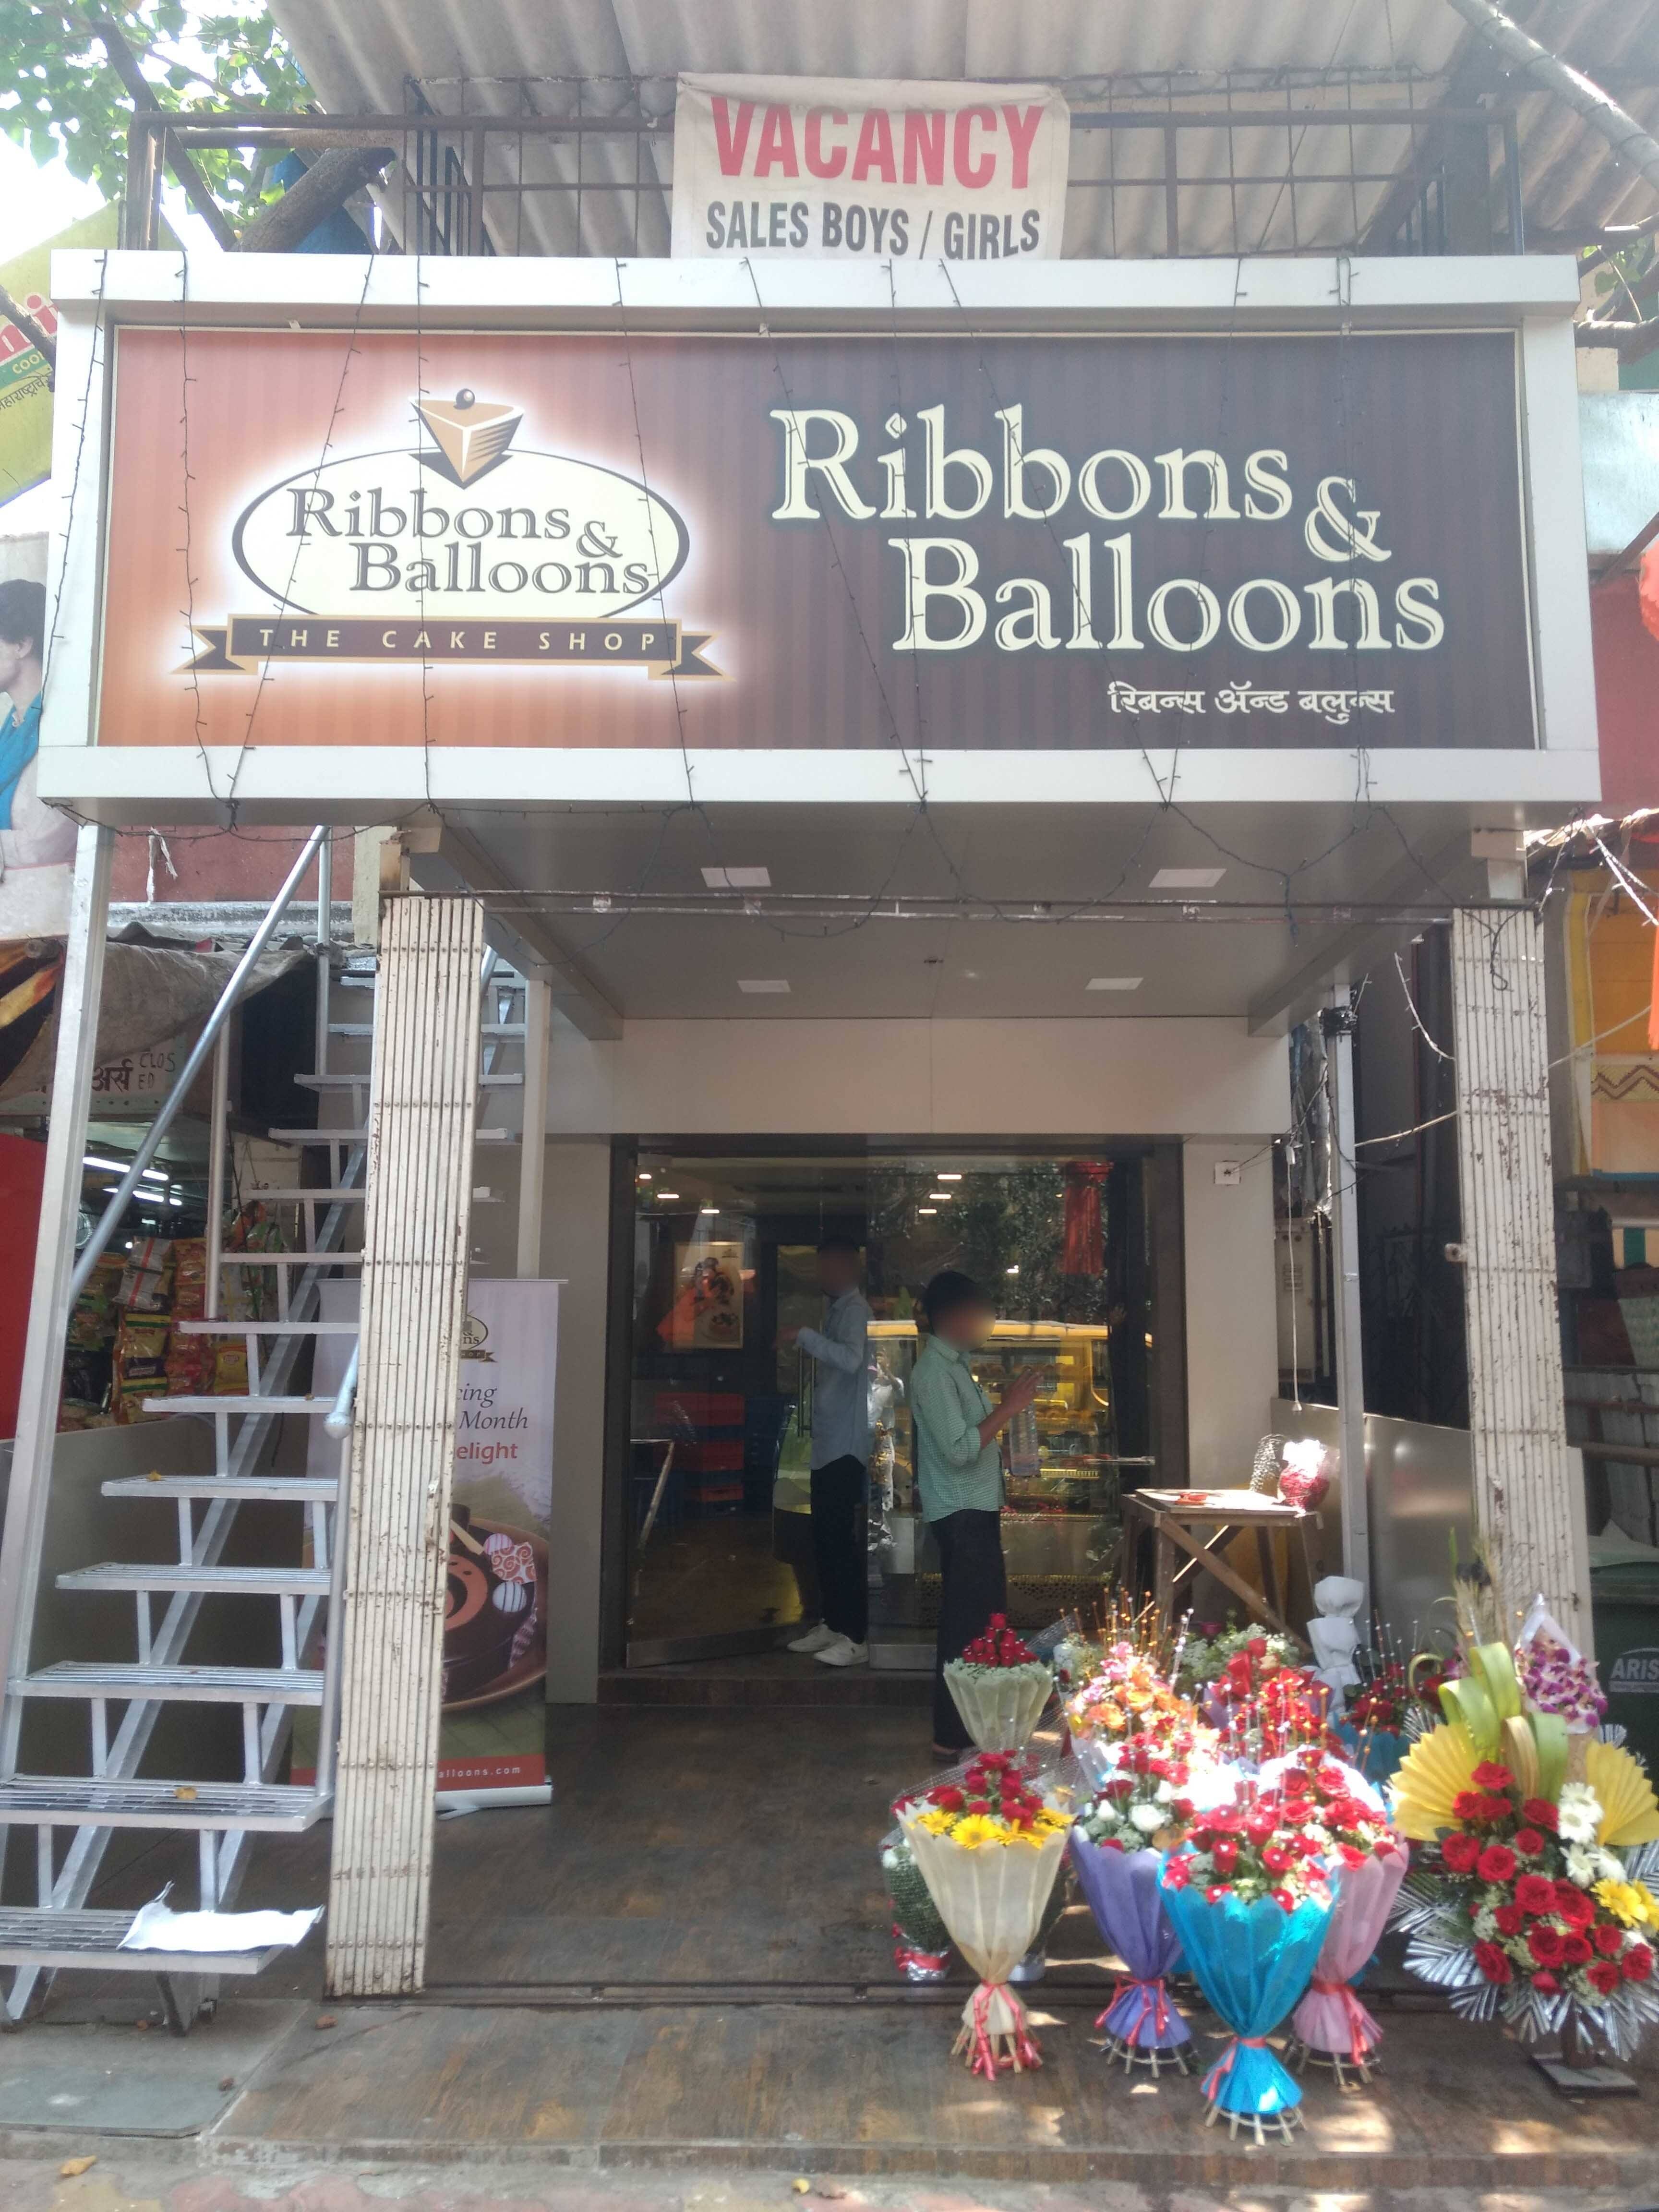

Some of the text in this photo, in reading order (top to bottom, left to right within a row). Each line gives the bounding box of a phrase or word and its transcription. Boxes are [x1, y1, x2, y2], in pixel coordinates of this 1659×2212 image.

[710, 96, 1045, 190] VACANCY
[706, 200, 809, 249] SALES
[822, 201, 909, 256] BOYS
[943, 208, 1040, 261] GIRLS
[12, 350, 46, 374] COO
[769, 403, 1293, 523] Ribbons
[286, 486, 571, 539] Ribbons
[1304, 476, 1393, 564] &
[576, 520, 623, 558] &
[349, 540, 650, 594] Balloons
[887, 532, 1446, 653] Balloons
[259, 628, 655, 651] THE CAKE SHOP
[91, 1058, 134, 1092] अर्स
[459, 1407, 528, 1429] Month
[455, 1442, 518, 1465] elight
[438, 1767, 521, 1779] alloons.com
